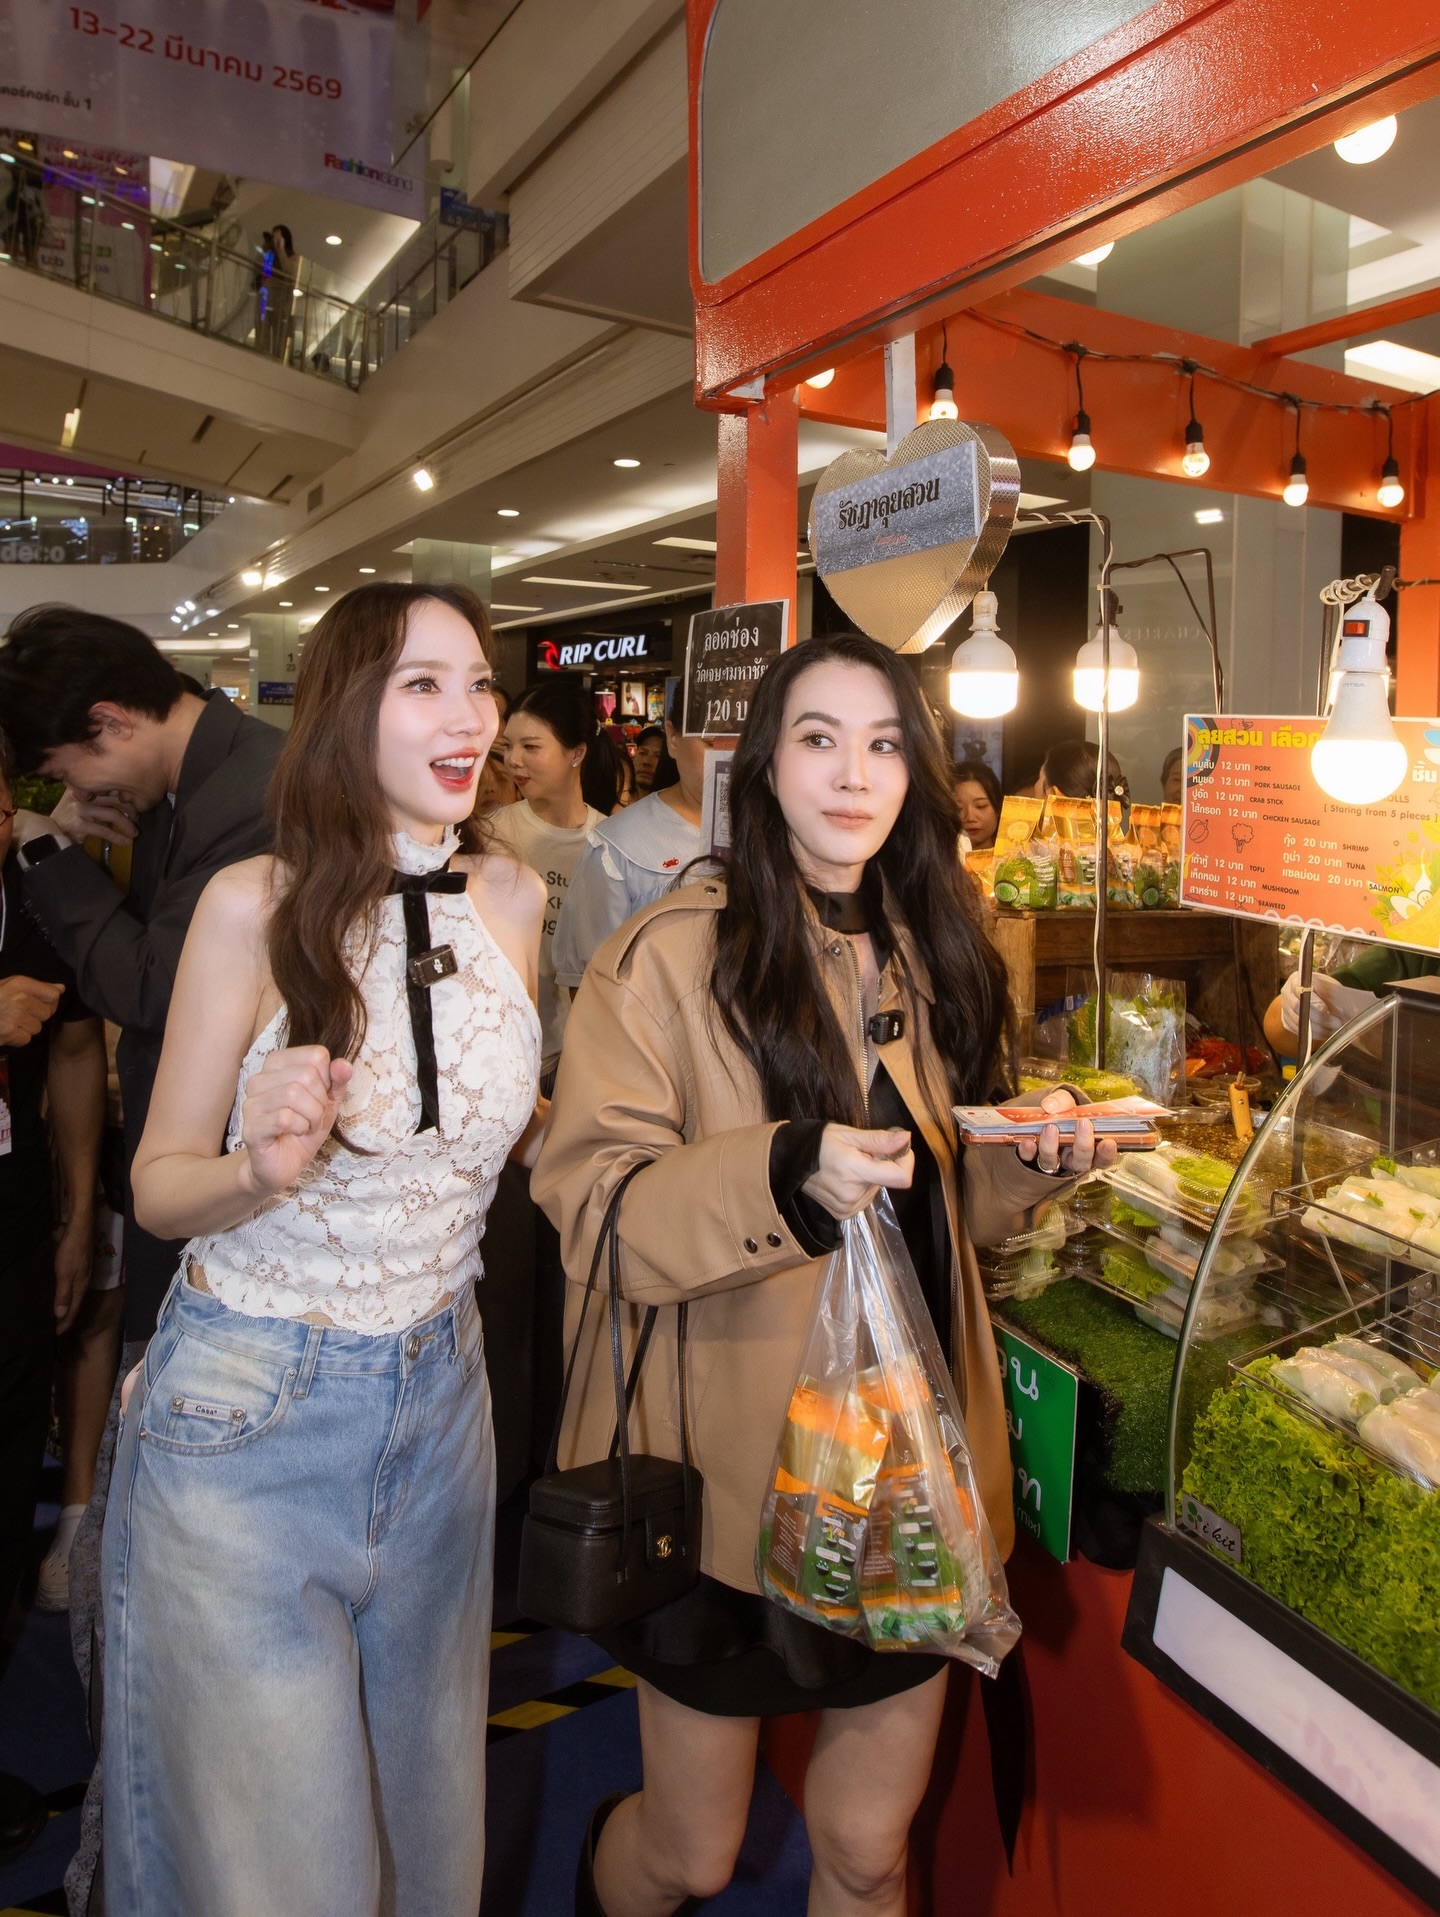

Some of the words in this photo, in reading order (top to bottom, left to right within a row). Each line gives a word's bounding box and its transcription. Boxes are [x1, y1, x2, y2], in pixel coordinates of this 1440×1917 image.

[164, 34, 264, 83] มีนาคม
[271, 65, 344, 100] 2569
[84, 98, 92, 110] 1
[704, 616, 760, 651] ลอดช่อง
[559, 642, 593, 665] RIP
[593, 634, 648, 662] CURL
[706, 699, 731, 722] 120
[1197, 728, 1264, 751] ลุยสวน
[1192, 758, 1215, 772] หมูสับ
[1221, 761, 1232, 771] 12
[1234, 762, 1251, 772] บาท
[1412, 760, 1438, 783] ชิ้น
[1192, 775, 1215, 786] หมูยอ
[1221, 776, 1232, 786] 12
[1234, 777, 1251, 787] บาท
[1272, 783, 1301, 791] SAUSAGE
[1215, 791, 1226, 801] 12
[1228, 792, 1245, 802] บาท
[1249, 796, 1265, 804] CRAB
[1384, 795, 1410, 804] OLLS
[1190, 802, 1221, 815] ไส้กรอก
[1227, 807, 1239, 817] 12
[1241, 809, 1258, 819] บาท
[1262, 814, 1289, 823] CHICKEN
[1291, 816, 1321, 826] SAUSAGE
[1330, 804, 1362, 816] Staring
[1365, 807, 1387, 817] from
[1390, 810, 1397, 818] 5
[1400, 811, 1431, 821] pieces
[1283, 833, 1296, 848] กุ้ง
[1303, 837, 1316, 848] 20
[1319, 840, 1338, 850] บาท
[1342, 843, 1370, 853] SHRIMP
[1190, 855, 1209, 869] เต้าหู้
[1214, 858, 1226, 868] 12
[1228, 861, 1244, 871] บาท
[1249, 865, 1265, 873] TOFU
[1283, 850, 1301, 864] ทูน่า
[1308, 855, 1321, 865] 20
[1324, 858, 1343, 868] บาท
[1346, 862, 1366, 870] TUNA
[1190, 869, 1220, 883] เห็ดหอม
[1226, 876, 1238, 885] 12
[1240, 878, 1257, 889] บาท
[1261, 884, 1300, 896] MUSHROOM
[1282, 868, 1320, 882] แซลม่อน
[1328, 874, 1341, 884] 20
[1344, 878, 1363, 888] บาท
[1368, 883, 1400, 894] SALMON
[1189, 884, 1219, 897] สาหร่าย
[1225, 891, 1236, 900] 12
[1238, 893, 1255, 904] บาท
[1258, 899, 1286, 910] SEAWEED
